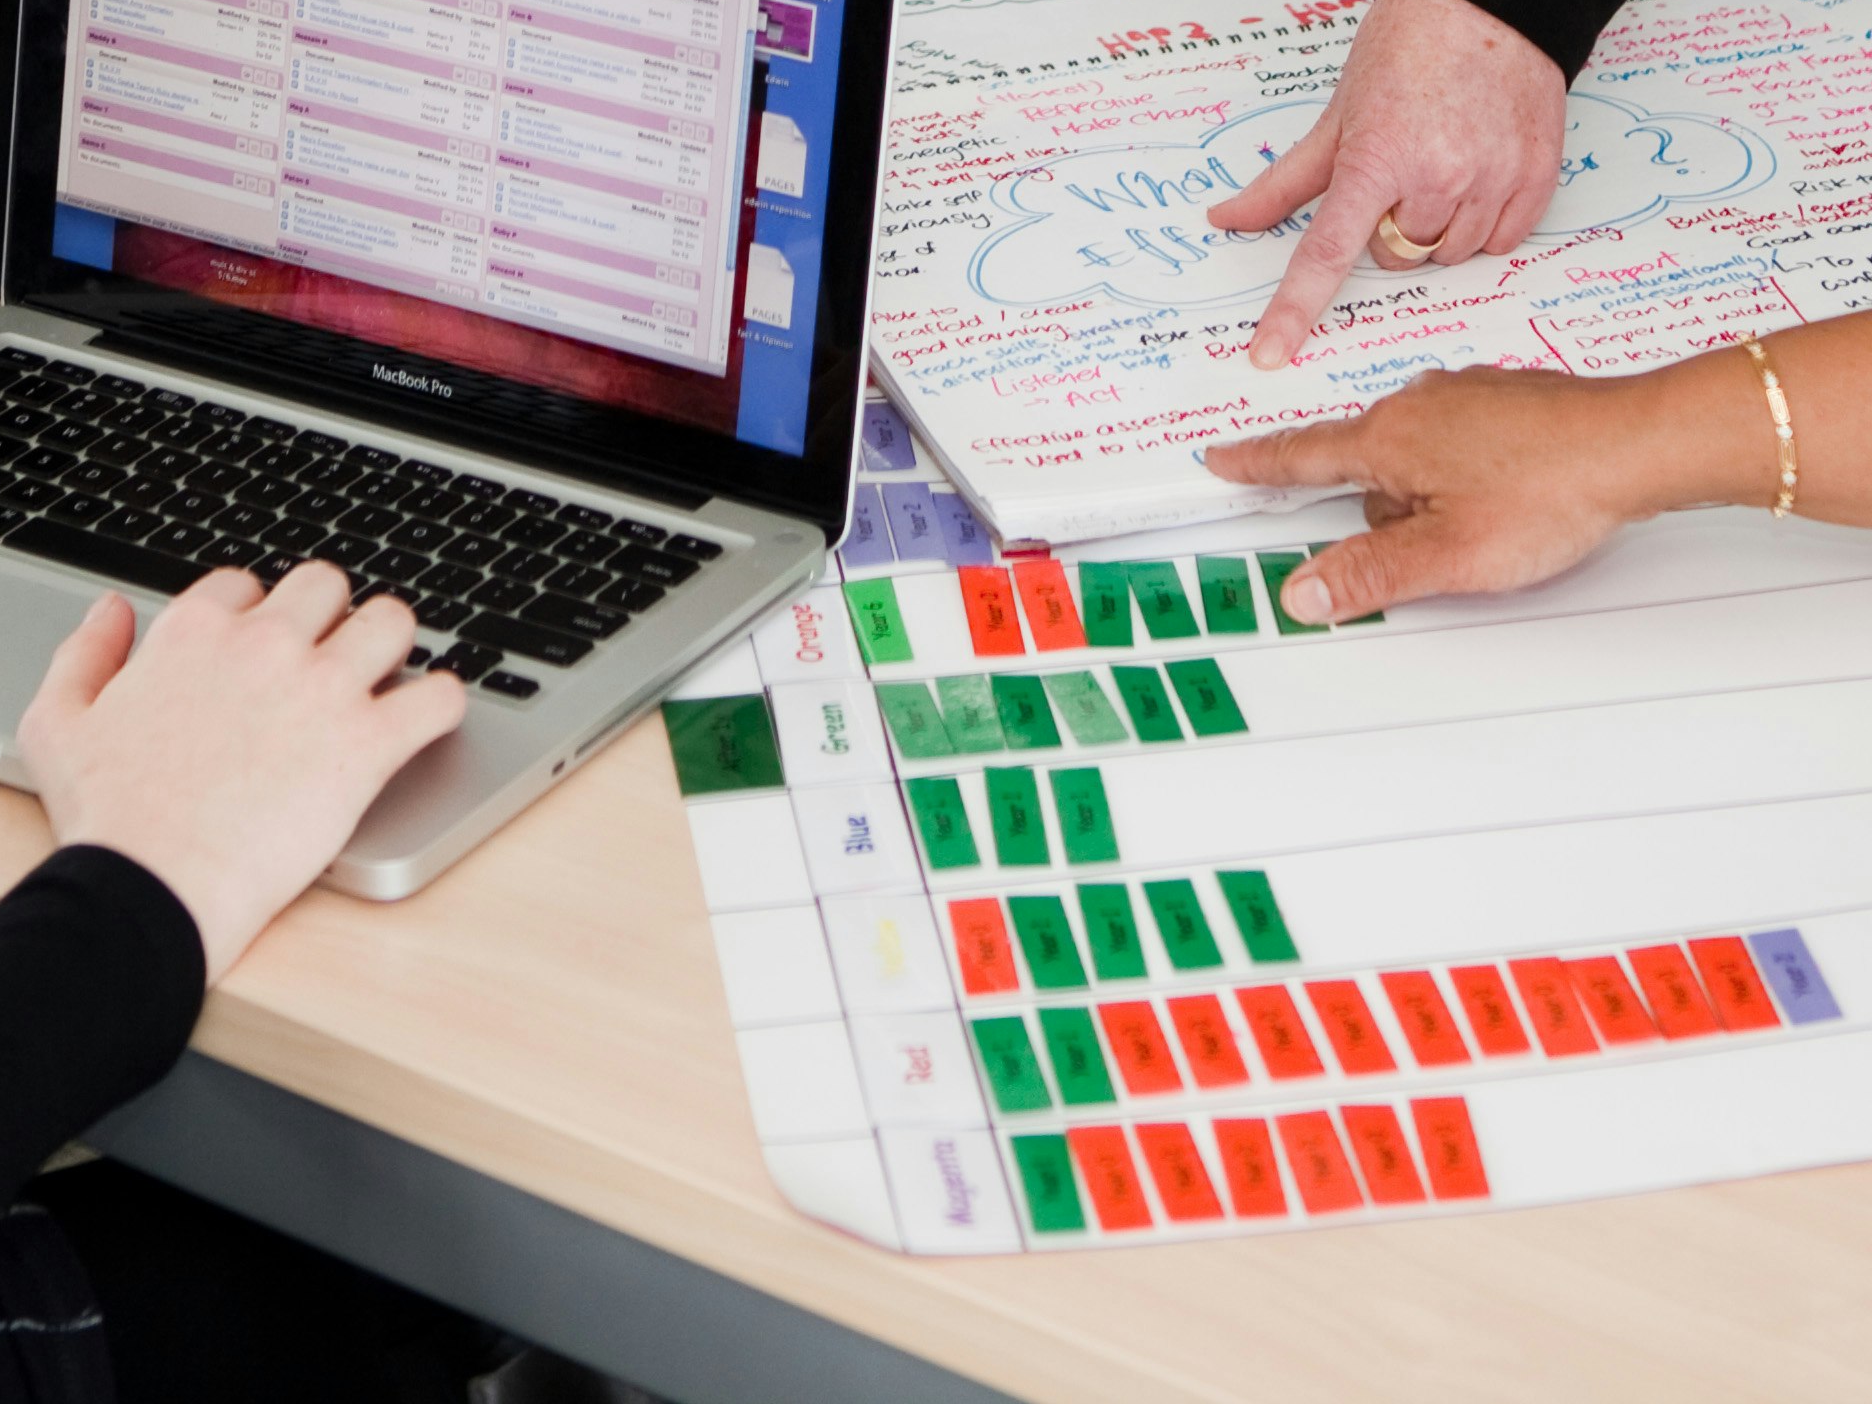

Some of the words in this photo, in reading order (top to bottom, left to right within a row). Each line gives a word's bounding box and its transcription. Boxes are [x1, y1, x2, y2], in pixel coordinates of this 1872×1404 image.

[1695, 43, 1810, 65] feedback
[765, 73, 790, 88] Edwin
[1021, 92, 1155, 123] Reflective
[1051, 114, 1122, 137] Make
[1129, 98, 1233, 126] change
[764, 176, 796, 193] PAGES
[1064, 156, 1247, 214] What
[1790, 179, 1847, 196] Risk
[1666, 206, 1750, 230] Builds
[1510, 225, 1625, 272] Personality
[1746, 232, 1815, 249] Good
[1564, 251, 1681, 286] Rapport
[1815, 255, 1855, 269] To
[752, 307, 783, 324] PAGES
[882, 315, 985, 343] scaffold
[1019, 299, 1096, 319] create
[930, 306, 959, 317] to
[1548, 311, 1605, 333] Less
[1612, 305, 1662, 322] can
[1672, 294, 1697, 311] be
[1702, 283, 1774, 305] more
[1138, 327, 1194, 346] Able
[1201, 322, 1230, 337] to
[1574, 325, 1655, 350] Deeper
[1664, 315, 1704, 331] not
[1715, 301, 1790, 323] wider
[891, 340, 948, 366] good
[1583, 355, 1621, 371] Do
[372, 363, 428, 393] MacBook
[430, 378, 452, 398] Pro
[990, 365, 1105, 397] Listener
[1327, 352, 1444, 383] Modelling
[1065, 386, 1125, 409] Act
[14, 414, 30, 424] Q
[61, 427, 81, 437] W
[970, 427, 1087, 453] Effective
[1095, 397, 1251, 437] assessment
[878, 427, 893, 450] Year
[1024, 450, 1085, 468] Used
[1098, 442, 1125, 455] to
[1136, 426, 1221, 452] inform
[1228, 399, 1366, 432] teaching
[856, 516, 873, 543] Year
[910, 512, 928, 539] Year
[959, 519, 975, 545] Year
[863, 602, 883, 611] 6
[988, 603, 1004, 633] Year
[1045, 599, 1063, 629] Year
[792, 604, 824, 664] Orange
[872, 611, 889, 640] Year
[820, 700, 851, 756] Green
[844, 815, 873, 855] Blue
